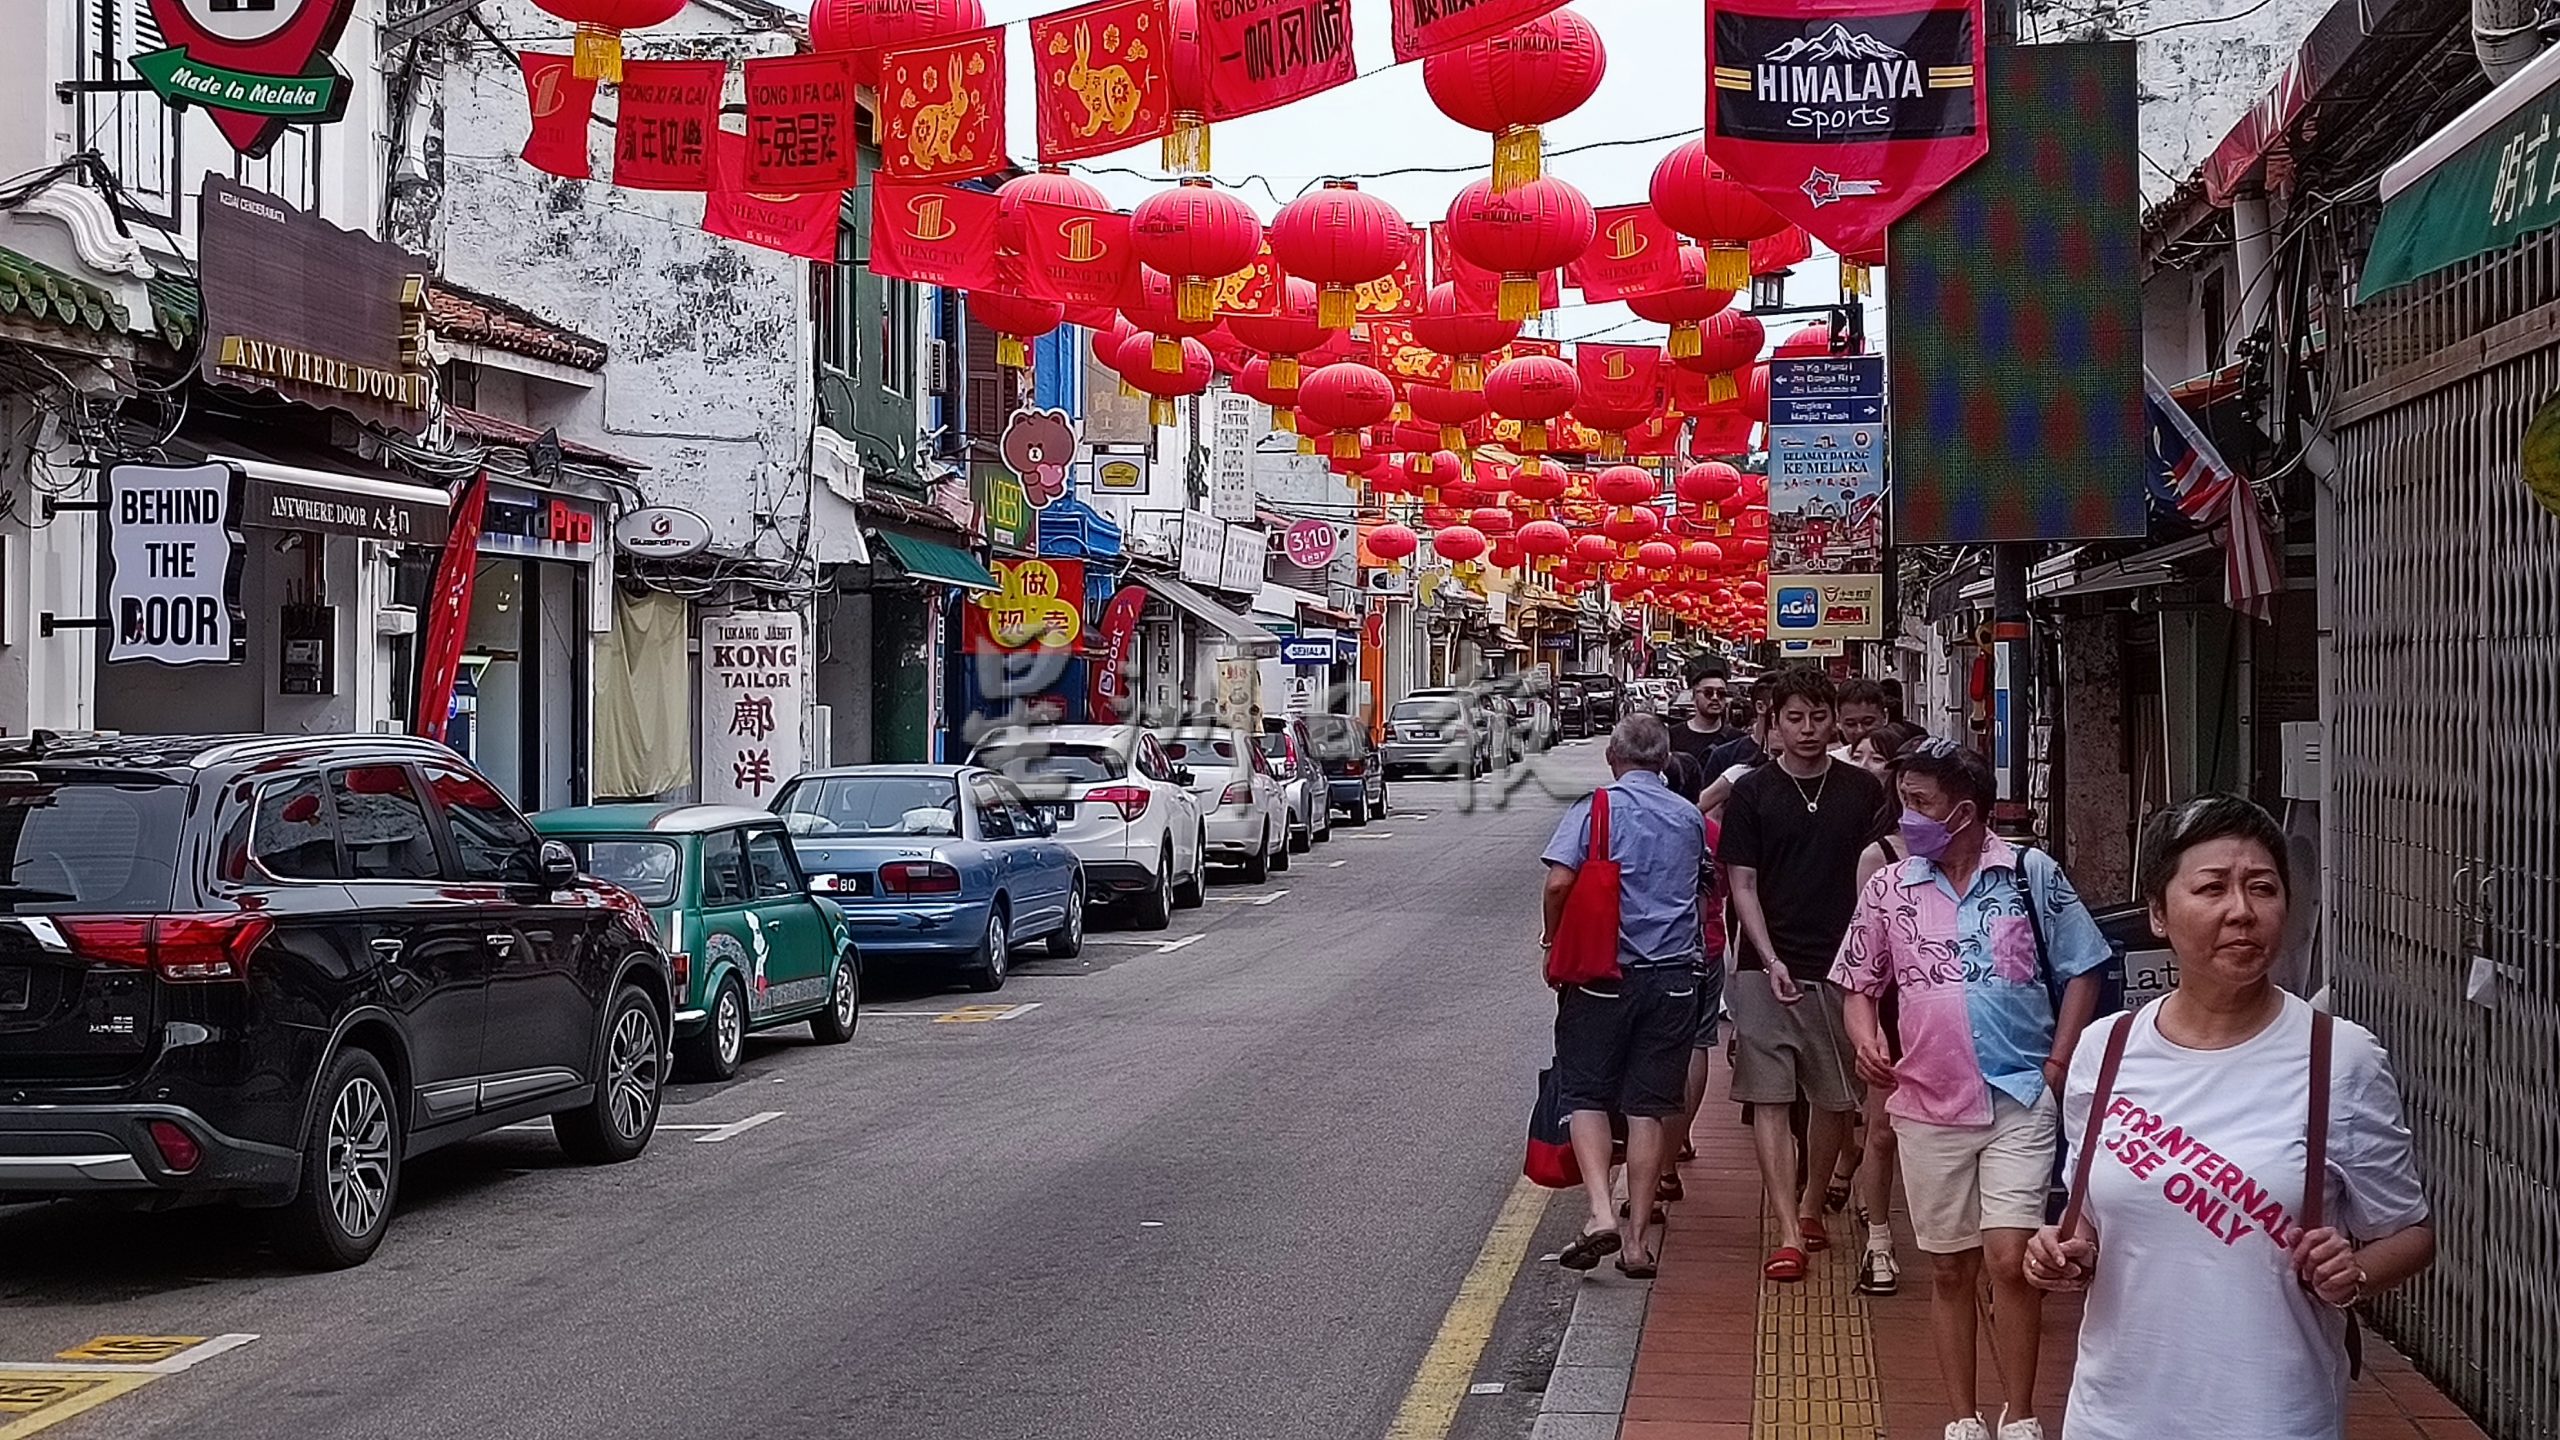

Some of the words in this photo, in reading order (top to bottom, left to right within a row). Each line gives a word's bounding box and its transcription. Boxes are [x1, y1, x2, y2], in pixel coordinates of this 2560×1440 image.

[1511, 36, 1562, 51] HIMALAYA
[170, 67, 221, 94] Made
[225, 81, 245, 101] In
[249, 83, 317, 106] Melaka
[803, 83, 820, 103] FA
[822, 80, 846, 101] CAI
[1757, 59, 1924, 104] HIMALAYA
[1786, 104, 1891, 140] Sports
[728, 202, 778, 225] SHENG
[782, 214, 807, 233] TAI
[236, 335, 349, 390] ANYWHERE
[356, 366, 408, 404] DOOR
[1221, 399, 1250, 411] KEDAI
[1221, 413, 1250, 426] ANTIK
[1784, 451, 1828, 461] SELAMAT
[1830, 451, 1870, 460] DATANG
[1784, 462, 1804, 475] KE
[1806, 461, 1868, 475] MELAKA
[120, 489, 219, 525] BEHIND
[272, 496, 335, 523] ANYWHERE
[336, 504, 367, 526] DOOR
[1291, 532, 1304, 552] 3
[1310, 526, 1331, 549] 10
[145, 542, 197, 578] THE
[1780, 601, 1816, 615] AGM
[120, 597, 219, 646] DOOR
[718, 626, 759, 641] TUKANG
[764, 626, 793, 641] JAHIT
[712, 644, 798, 668] KONG
[1292, 645, 1327, 657] SEHALA
[720, 672, 792, 689] TAILOR
[2103, 1096, 2163, 1138] FOR
[2163, 1172, 2256, 1247] ONLY
